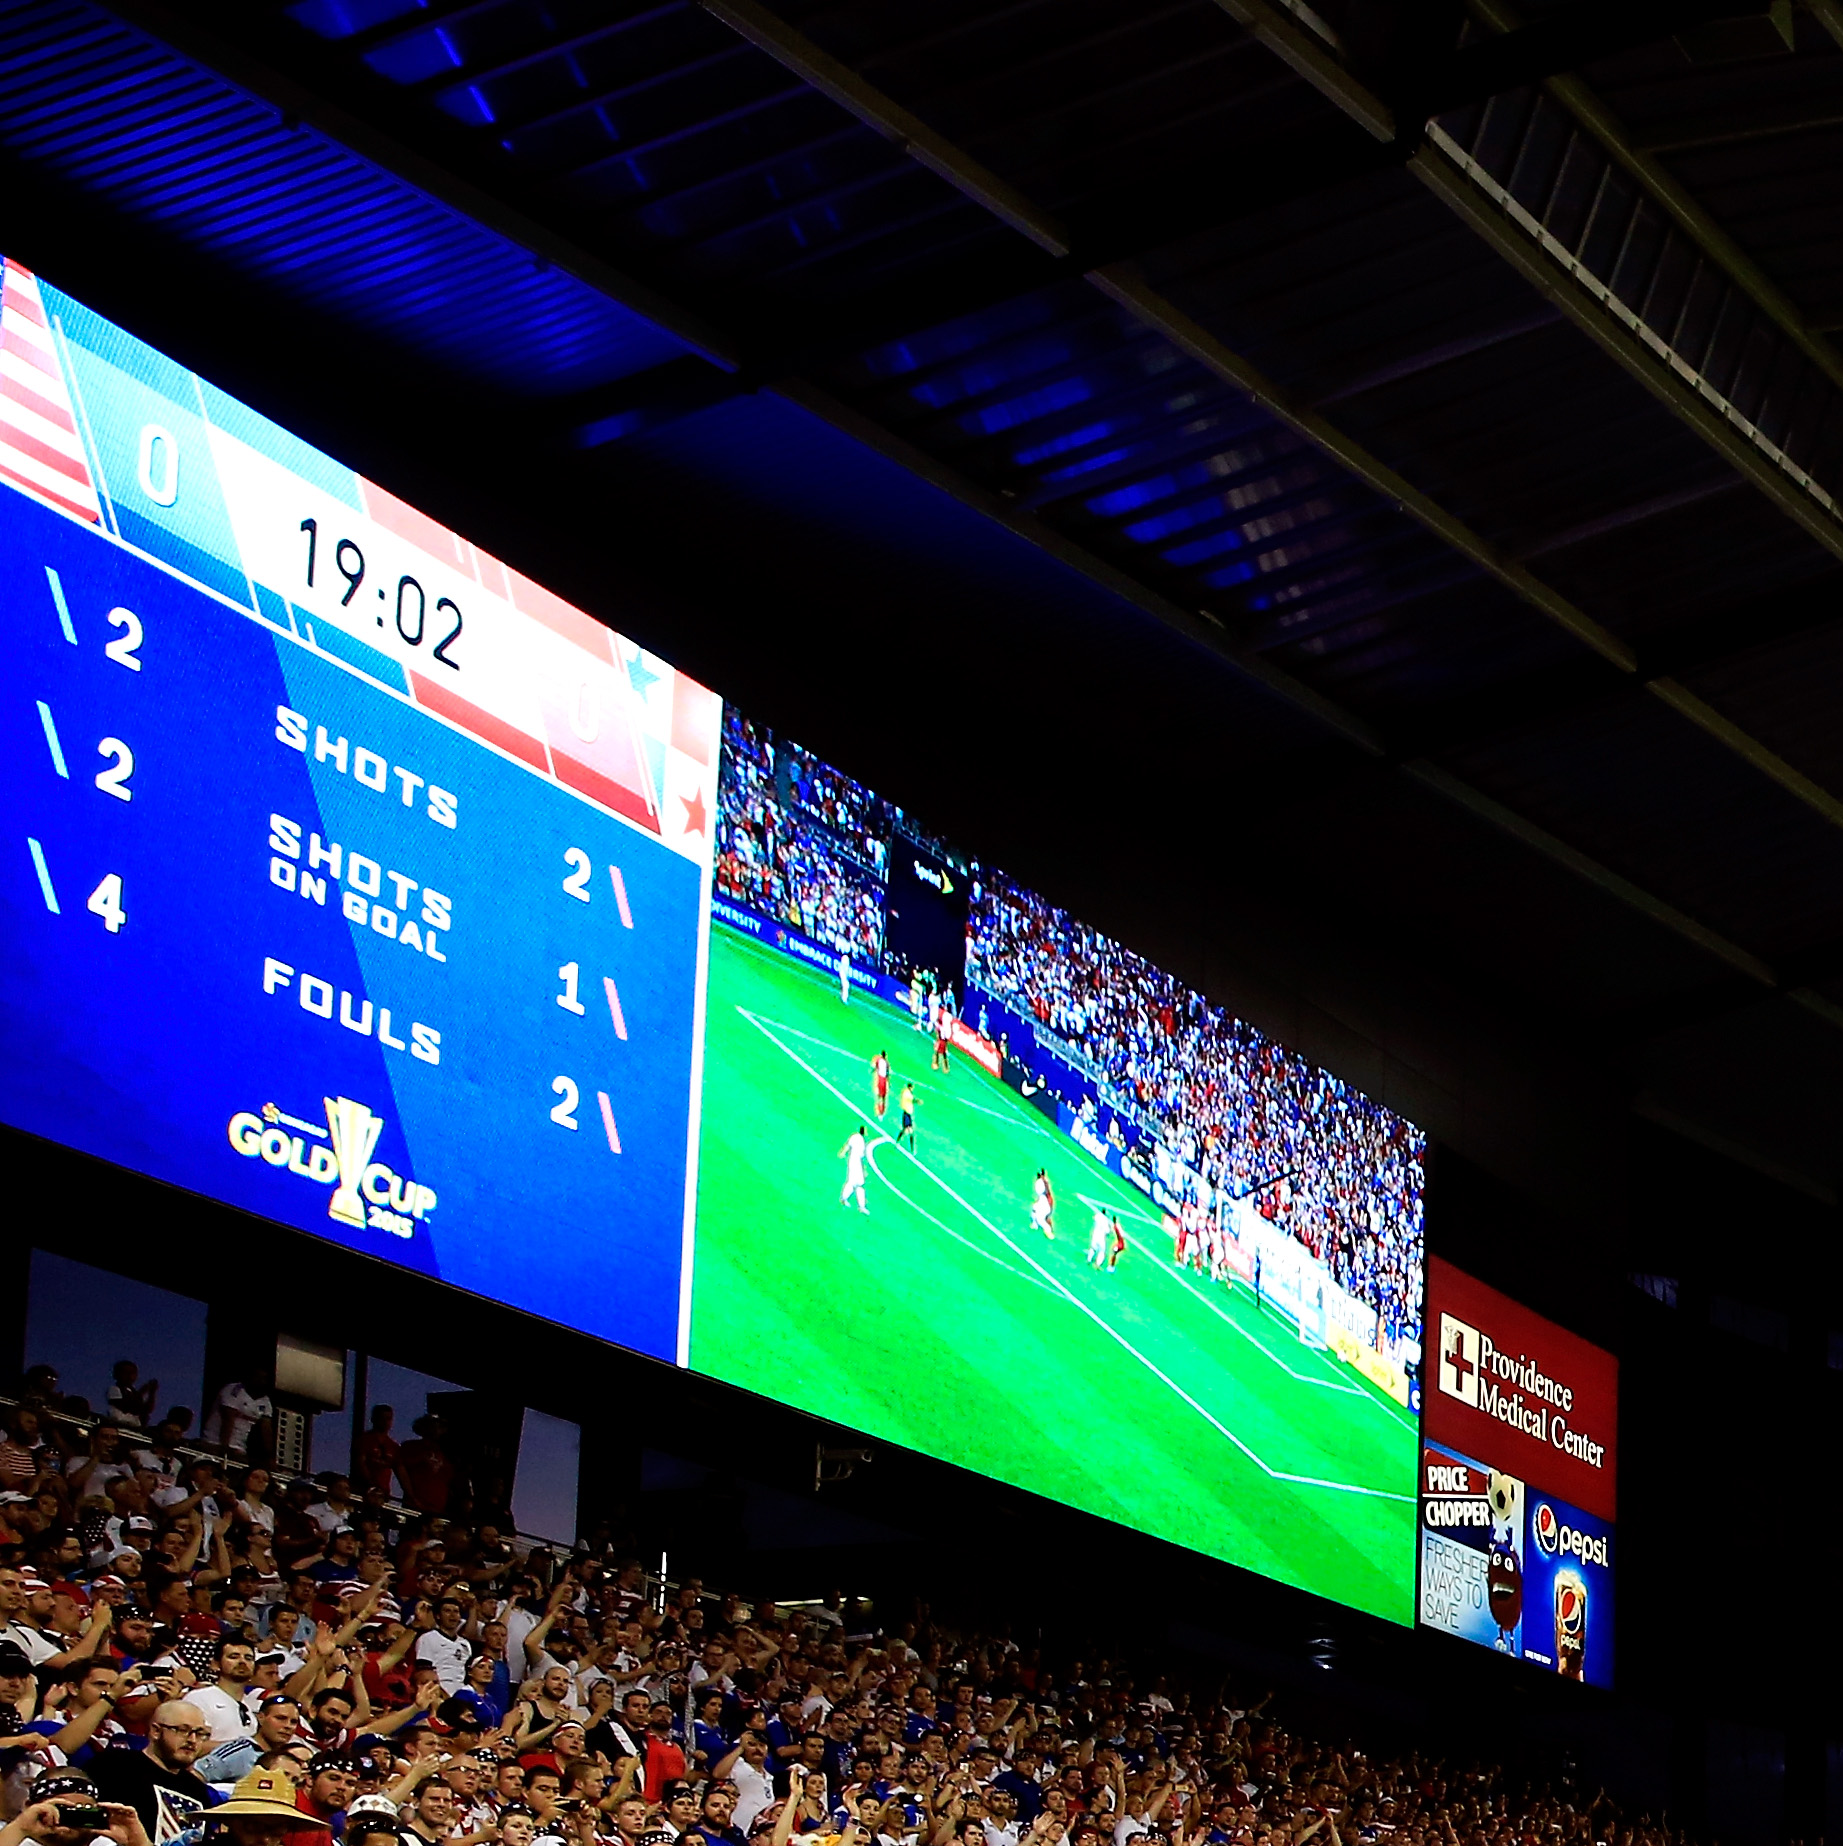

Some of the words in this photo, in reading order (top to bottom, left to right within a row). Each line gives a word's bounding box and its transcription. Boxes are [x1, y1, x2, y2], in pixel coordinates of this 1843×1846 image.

[138, 424, 179, 507] 0
[299, 517, 464, 671] 19:02
[104, 607, 144, 672] 2
[95, 737, 135, 802] 2
[275, 705, 459, 829] SHOTS
[86, 872, 127, 934] 4
[269, 813, 452, 931] SHOTS
[562, 847, 592, 903] 2
[269, 857, 326, 906] ON
[342, 899, 448, 963] GOAL
[262, 956, 442, 1065] FOULS
[556, 961, 586, 1016] 1
[550, 1075, 580, 1131] 2
[228, 1111, 341, 1184] GOLD
[361, 1162, 438, 1219] CUP
[367, 1205, 415, 1239] 2015
[1479, 1332, 1573, 1412] Providence
[1478, 1377, 1547, 1442] Medical
[1551, 1417, 1604, 1469] Center
[1427, 1466, 1469, 1492] PRICE
[1426, 1500, 1490, 1527] CHOPPER
[1426, 1537, 1489, 1582] FRESHER
[1559, 1525, 1609, 1567] pepsi
[1425, 1568, 1462, 1603] WAYS
[1465, 1584, 1483, 1610] TO
[1425, 1592, 1461, 1629] SAVE
